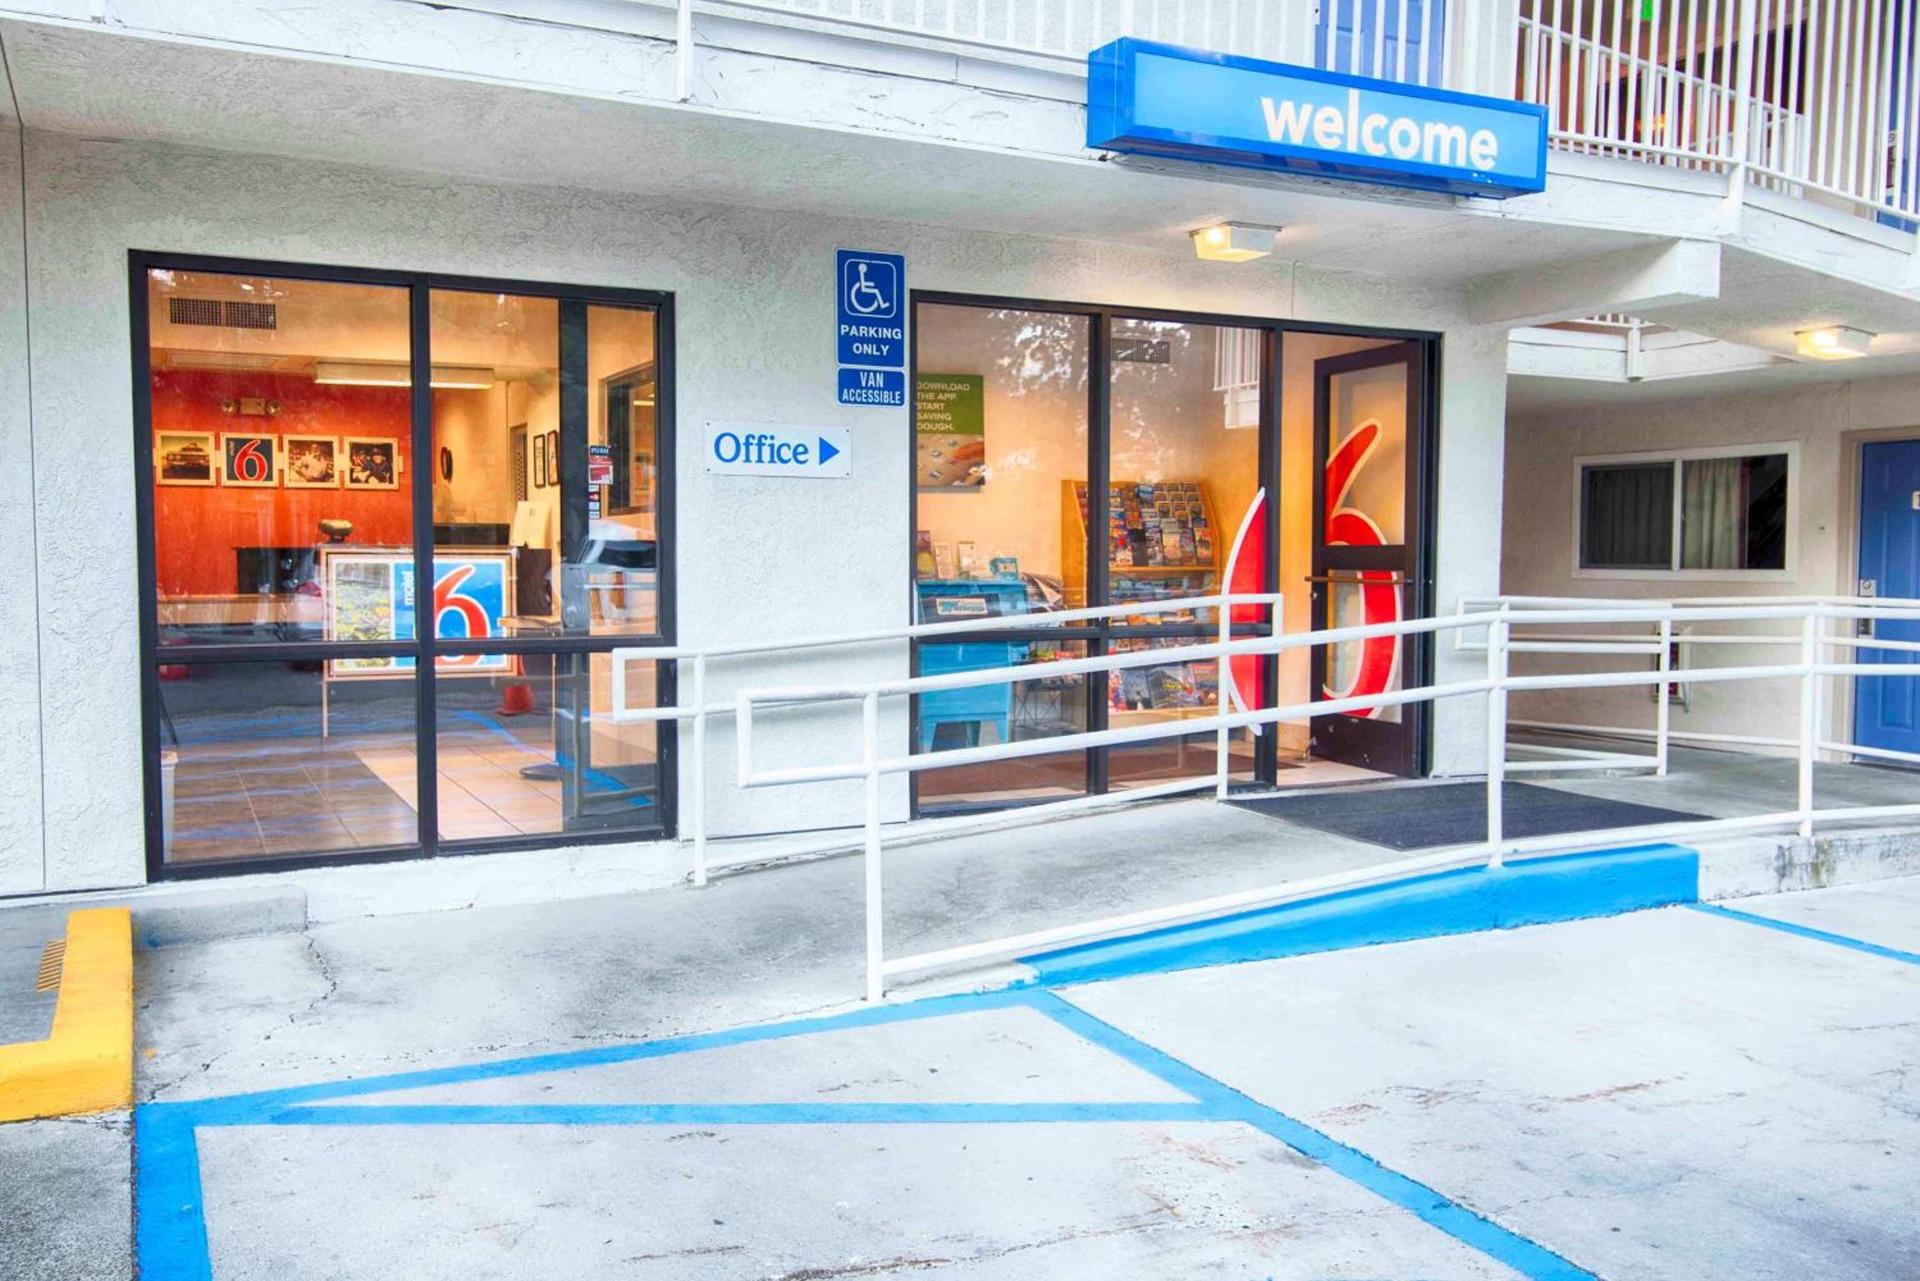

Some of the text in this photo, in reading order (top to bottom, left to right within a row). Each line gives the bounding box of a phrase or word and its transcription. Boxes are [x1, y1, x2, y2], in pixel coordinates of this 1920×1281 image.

[1260, 87, 1499, 171] welcome
[840, 324, 902, 340] PARKING
[852, 342, 890, 356] ONLY
[859, 371, 884, 388] VAN
[842, 388, 901, 404] ACCESSIBLE
[917, 402, 945, 411] START
[591, 447, 609, 455] PUSH
[714, 432, 809, 465] Office
